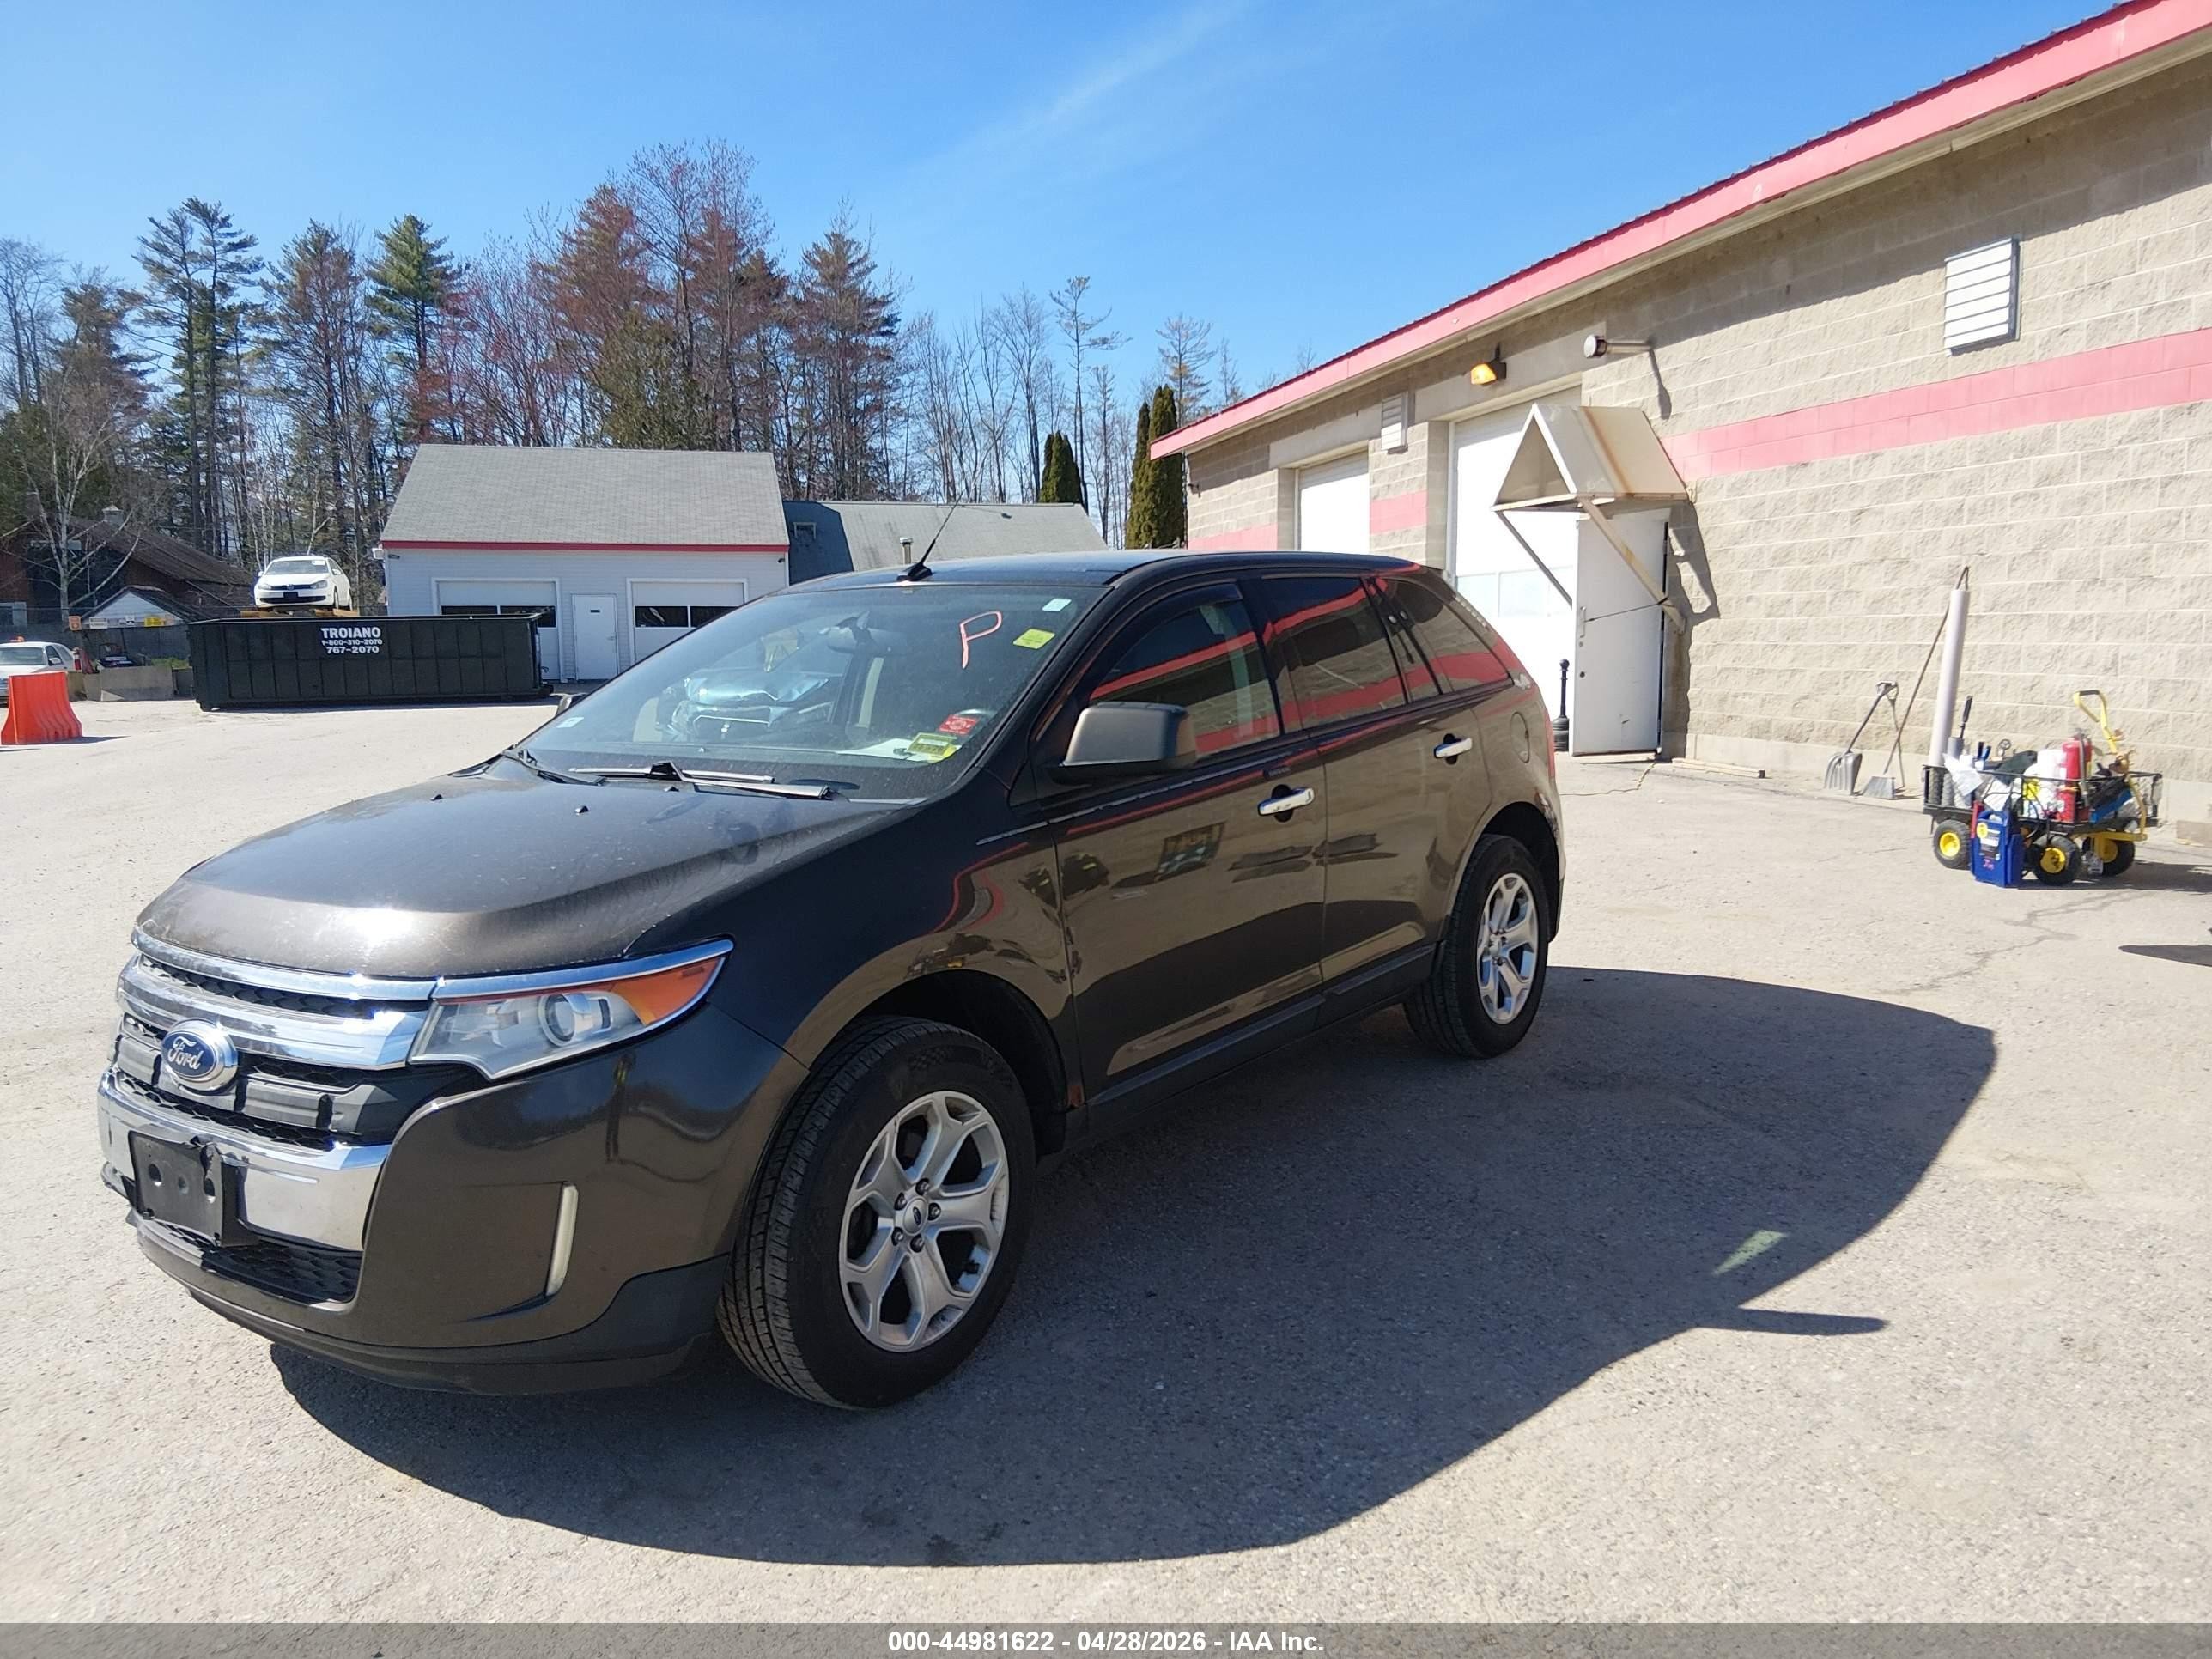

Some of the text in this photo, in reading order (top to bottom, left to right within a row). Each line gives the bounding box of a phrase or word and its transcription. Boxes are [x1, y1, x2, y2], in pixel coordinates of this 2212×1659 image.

[320, 627, 381, 639] TROIANO
[959, 611, 1002, 670] P
[326, 646, 380, 654] 767-2070
[167, 1036, 204, 1070] Ford
